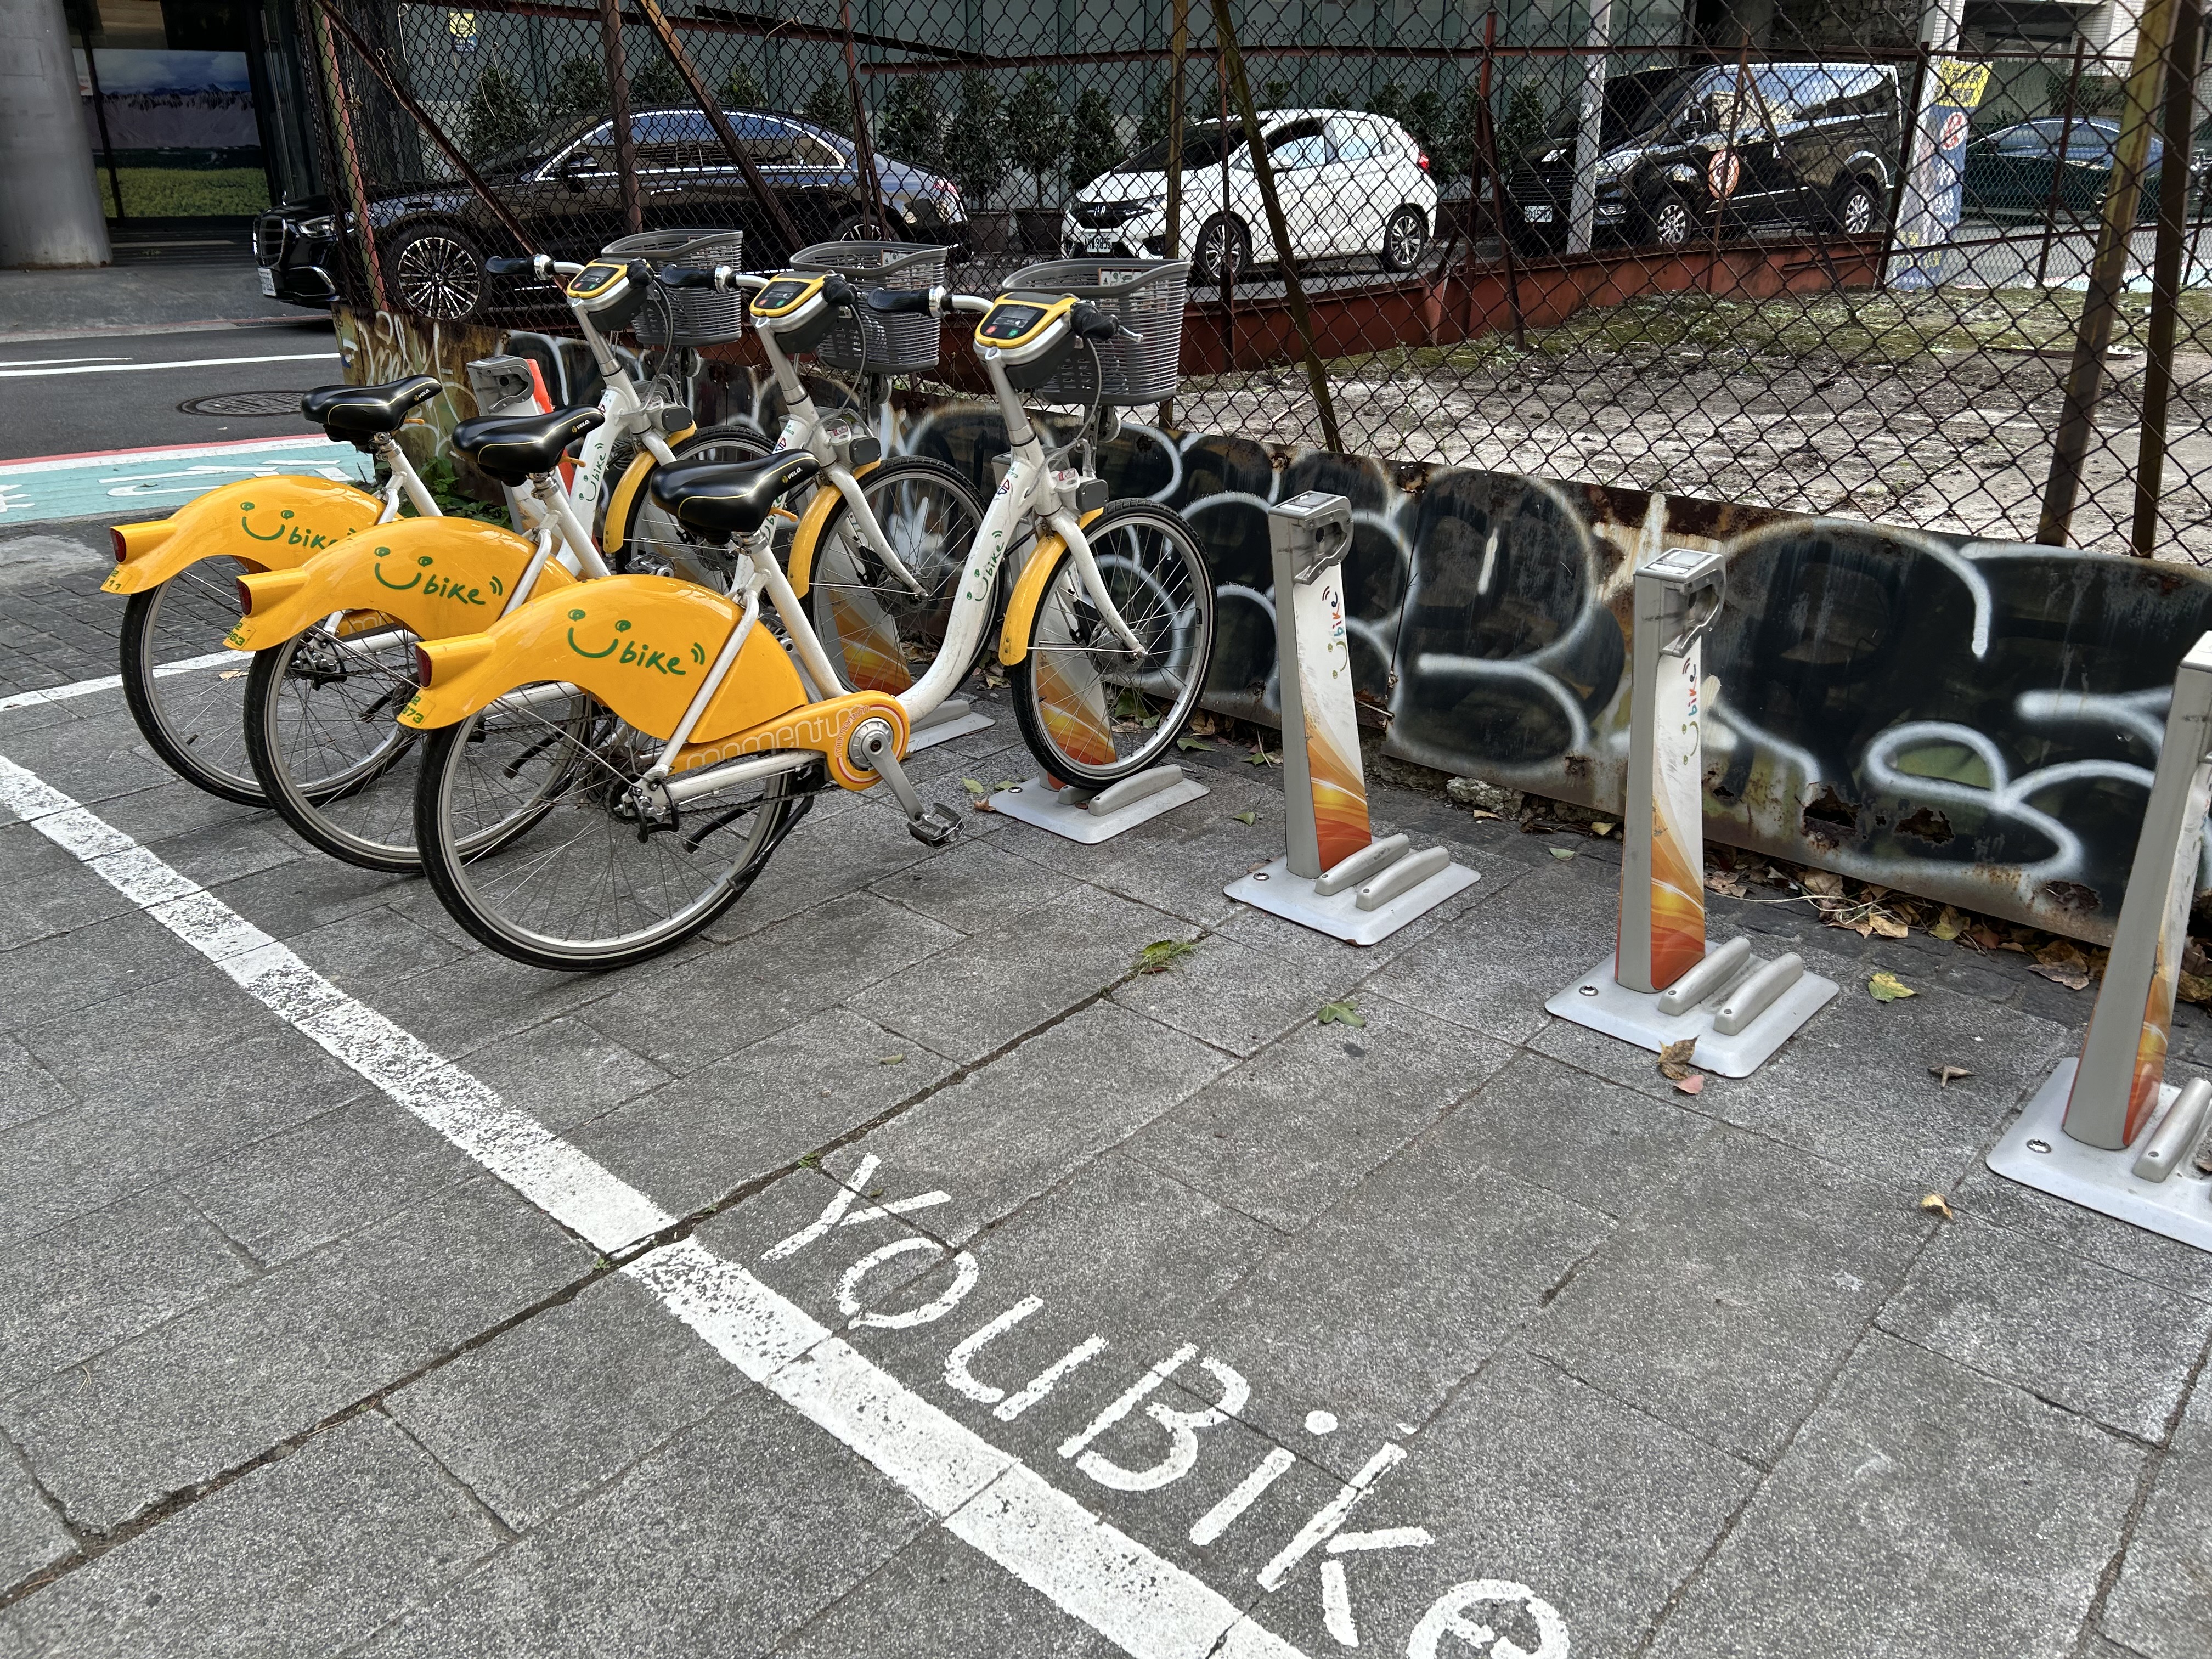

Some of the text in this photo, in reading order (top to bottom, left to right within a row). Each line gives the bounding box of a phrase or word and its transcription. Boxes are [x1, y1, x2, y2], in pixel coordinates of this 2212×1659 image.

[576, 420, 590, 430] VELO
[787, 467, 802, 479] VELO
[834, 705, 870, 757] momentum
